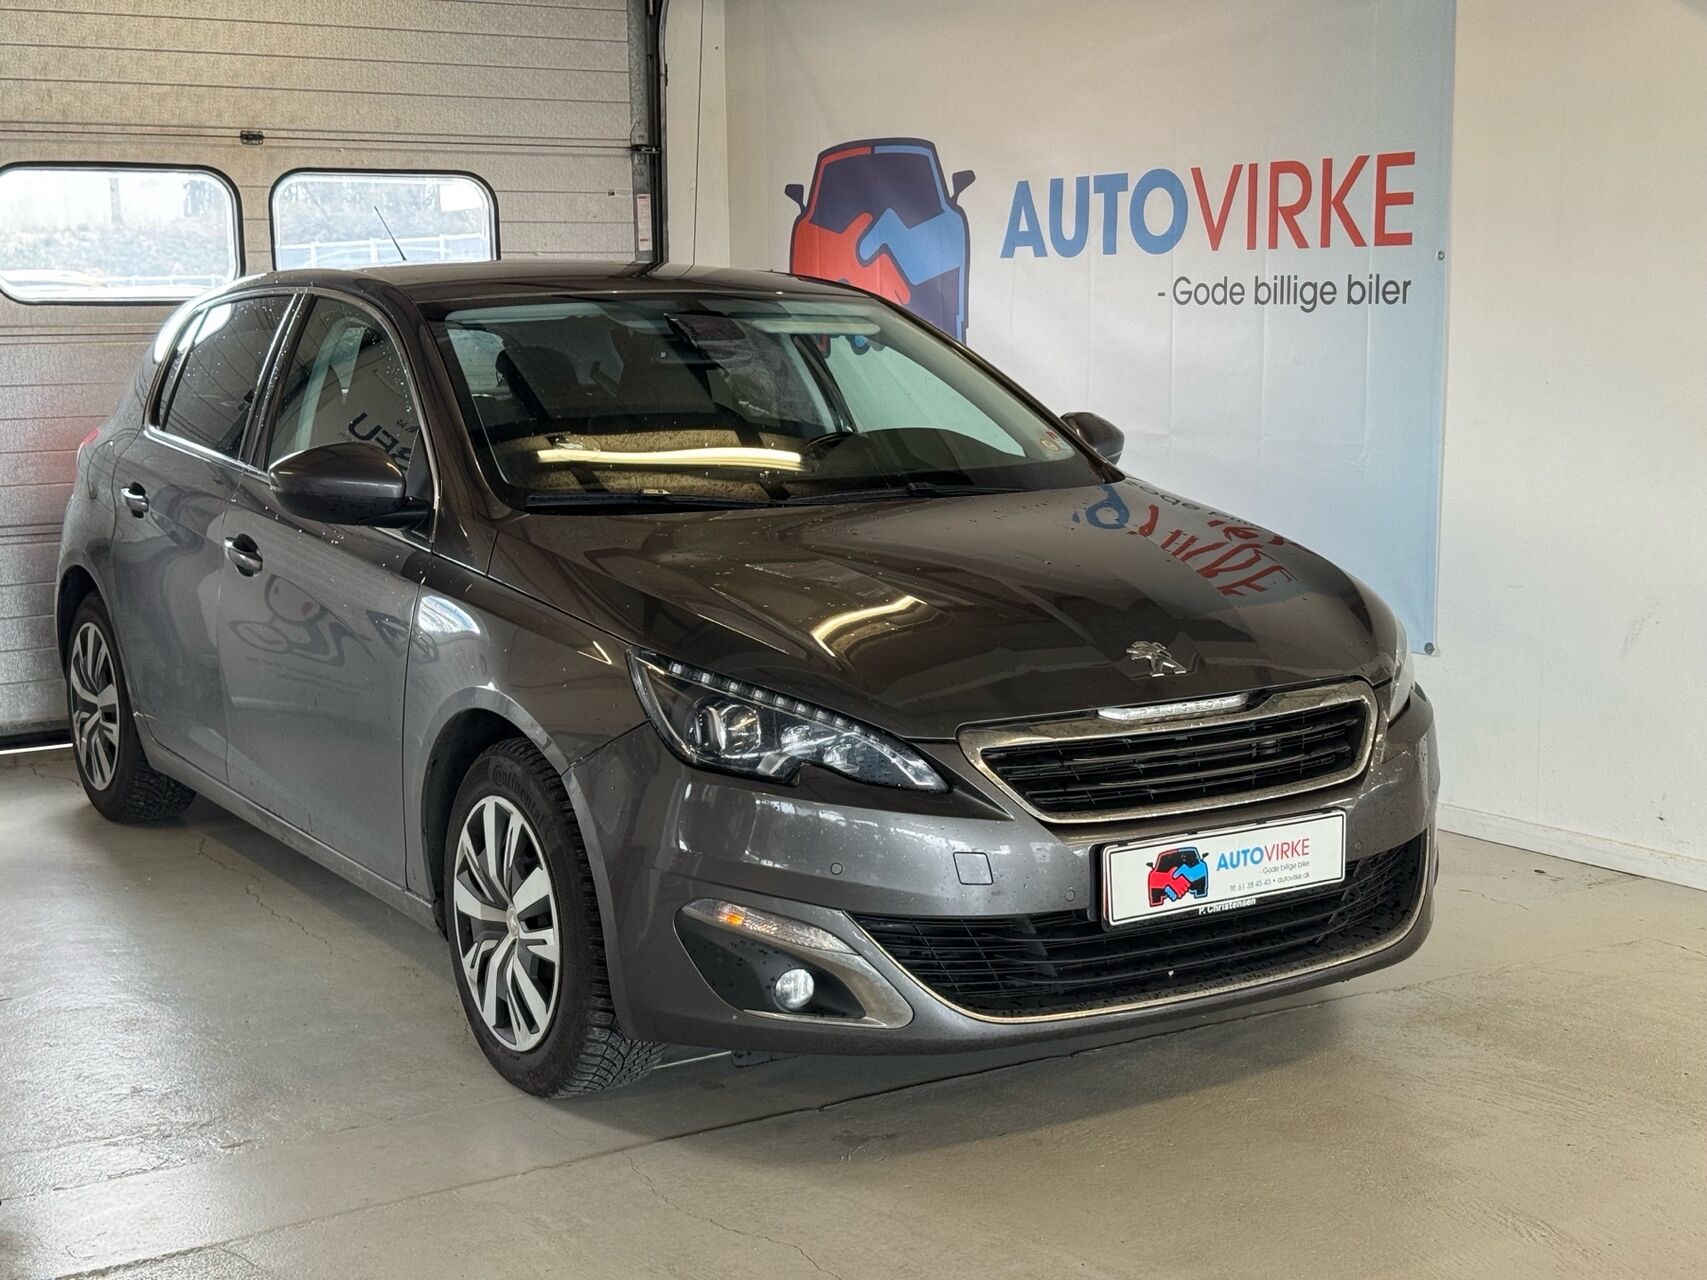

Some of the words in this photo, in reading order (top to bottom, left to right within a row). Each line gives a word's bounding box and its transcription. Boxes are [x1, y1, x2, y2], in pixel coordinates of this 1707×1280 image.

[1000, 151, 1416, 258] AUTOVIRKE
[1172, 275, 1245, 306] Gode
[1254, 275, 1337, 313] billige
[1347, 273, 1412, 305] biler
[1217, 838, 1310, 871] AUTOVIRKE
[1262, 866, 1280, 874] Gode
[1198, 906, 1206, 915] P.
[1207, 898, 1256, 913] Christensen
